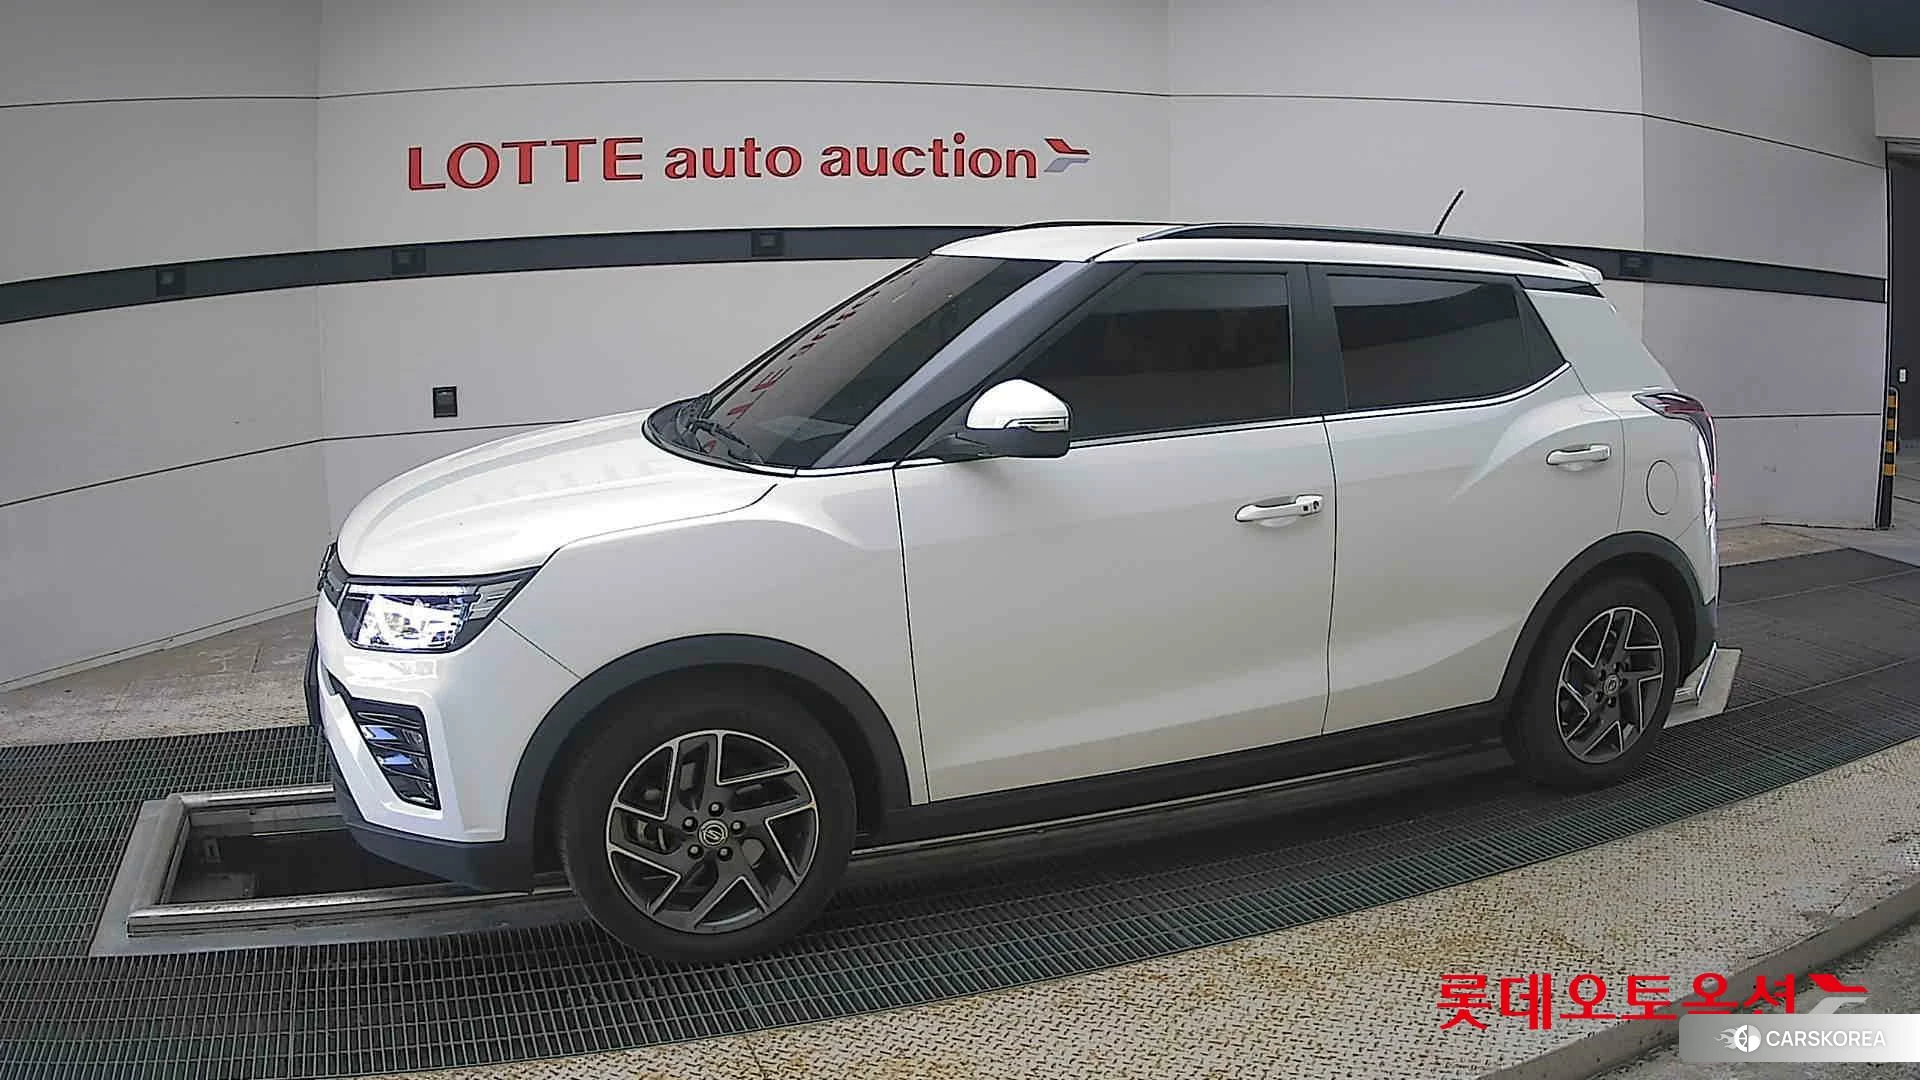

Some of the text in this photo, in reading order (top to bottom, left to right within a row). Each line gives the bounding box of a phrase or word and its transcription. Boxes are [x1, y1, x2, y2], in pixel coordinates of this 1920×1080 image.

[408, 132, 1037, 191] LOTTE auto auction
